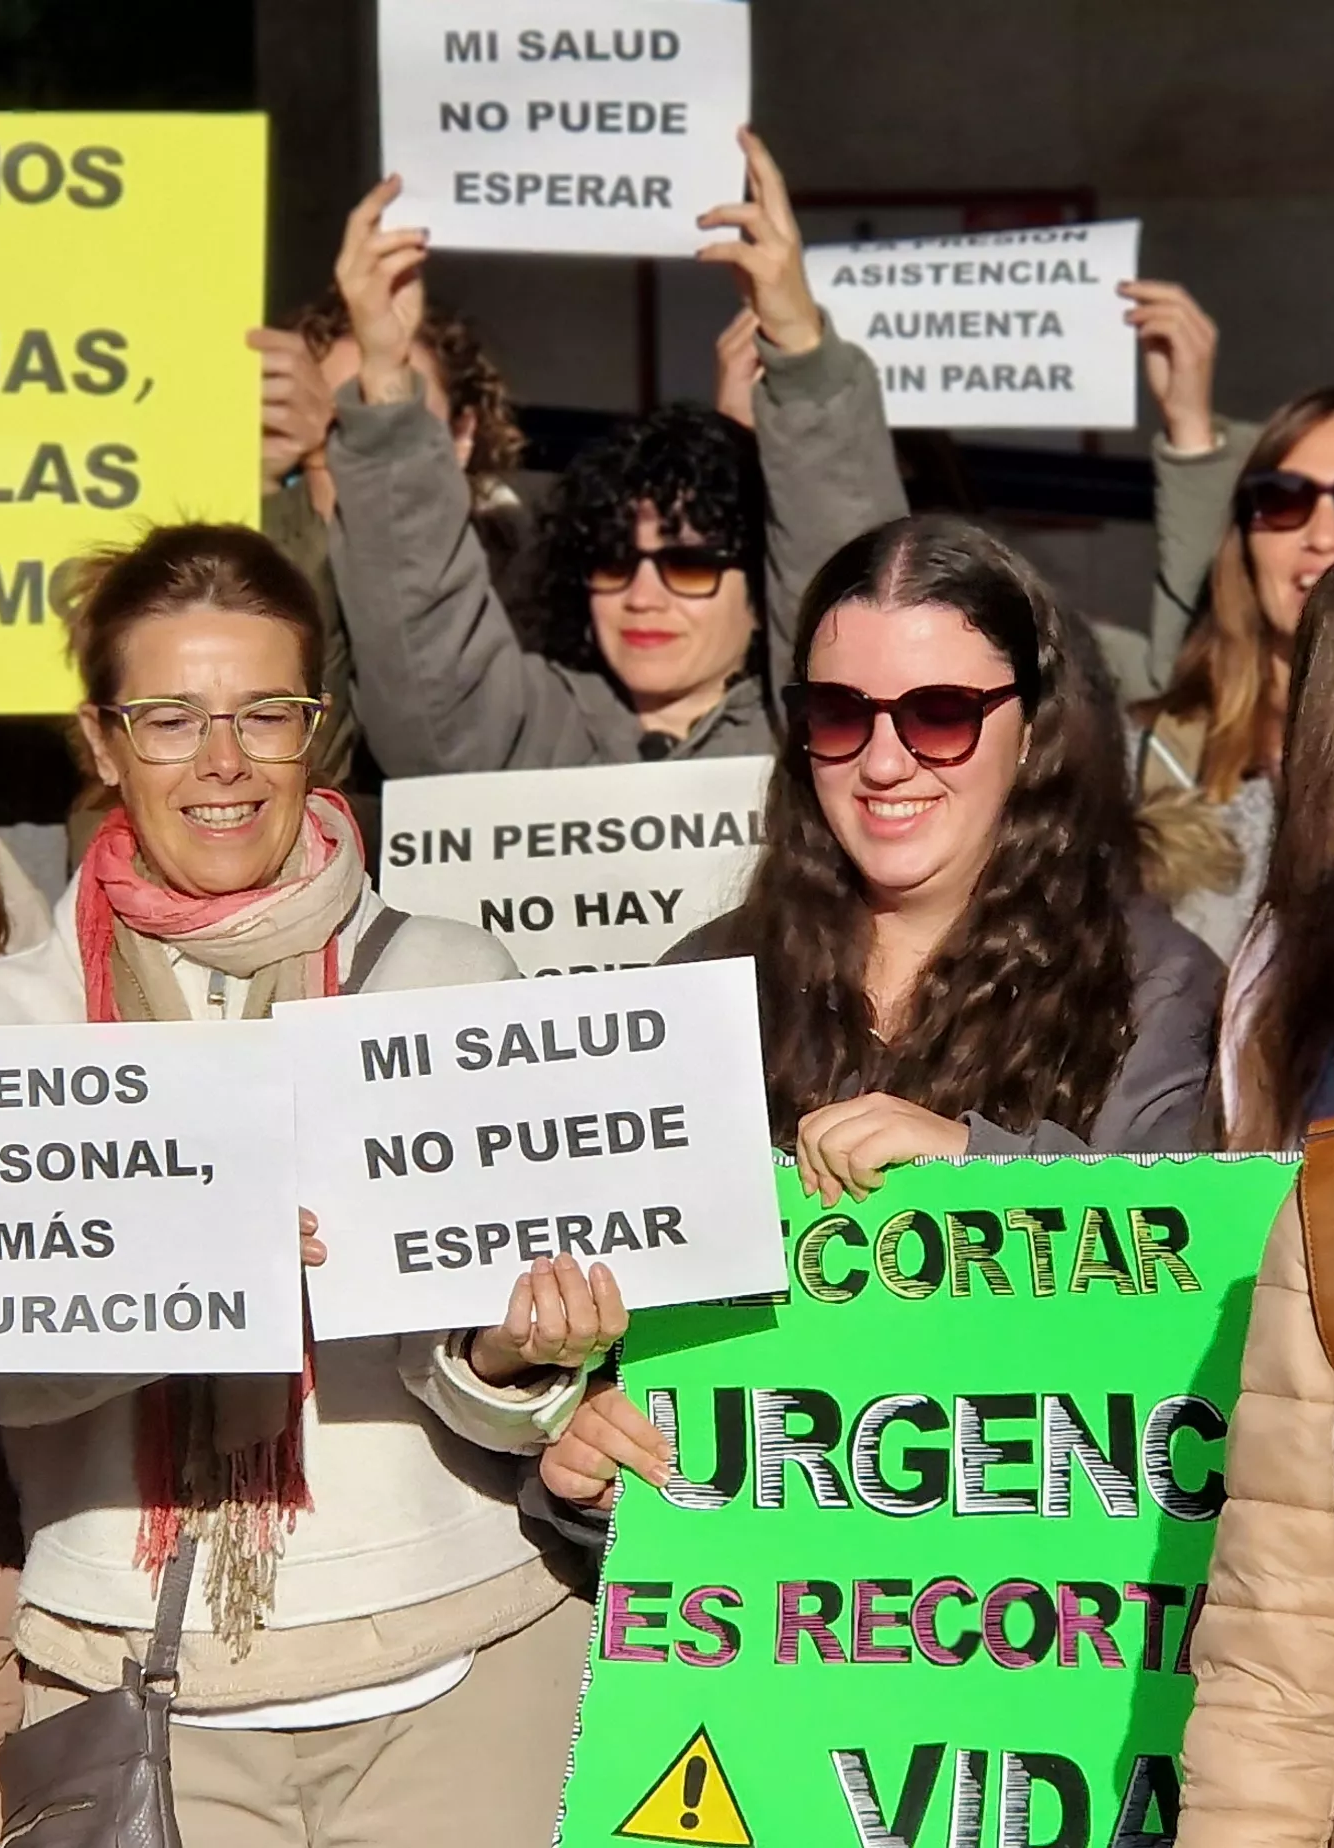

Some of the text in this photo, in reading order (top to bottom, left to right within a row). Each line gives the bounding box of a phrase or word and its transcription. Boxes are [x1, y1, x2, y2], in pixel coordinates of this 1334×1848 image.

[444, 28, 681, 63] MI SALUD
[440, 101, 688, 135] NO PUEDE
[453, 171, 672, 209] ESPERAR
[832, 259, 1100, 288] ASISTENCIAL
[867, 310, 1064, 339] AUMENTA
[875, 363, 1074, 392] IN PARAR
[388, 827, 472, 868] SIN
[480, 887, 684, 934] NO HAY
[361, 1008, 668, 1082] MI SALUD
[364, 1105, 690, 1180] NO PUEDE
[394, 1204, 688, 1275] ESPERAR
[598, 1581, 744, 1669] ES
[829, 1742, 1181, 1848] VIDA
